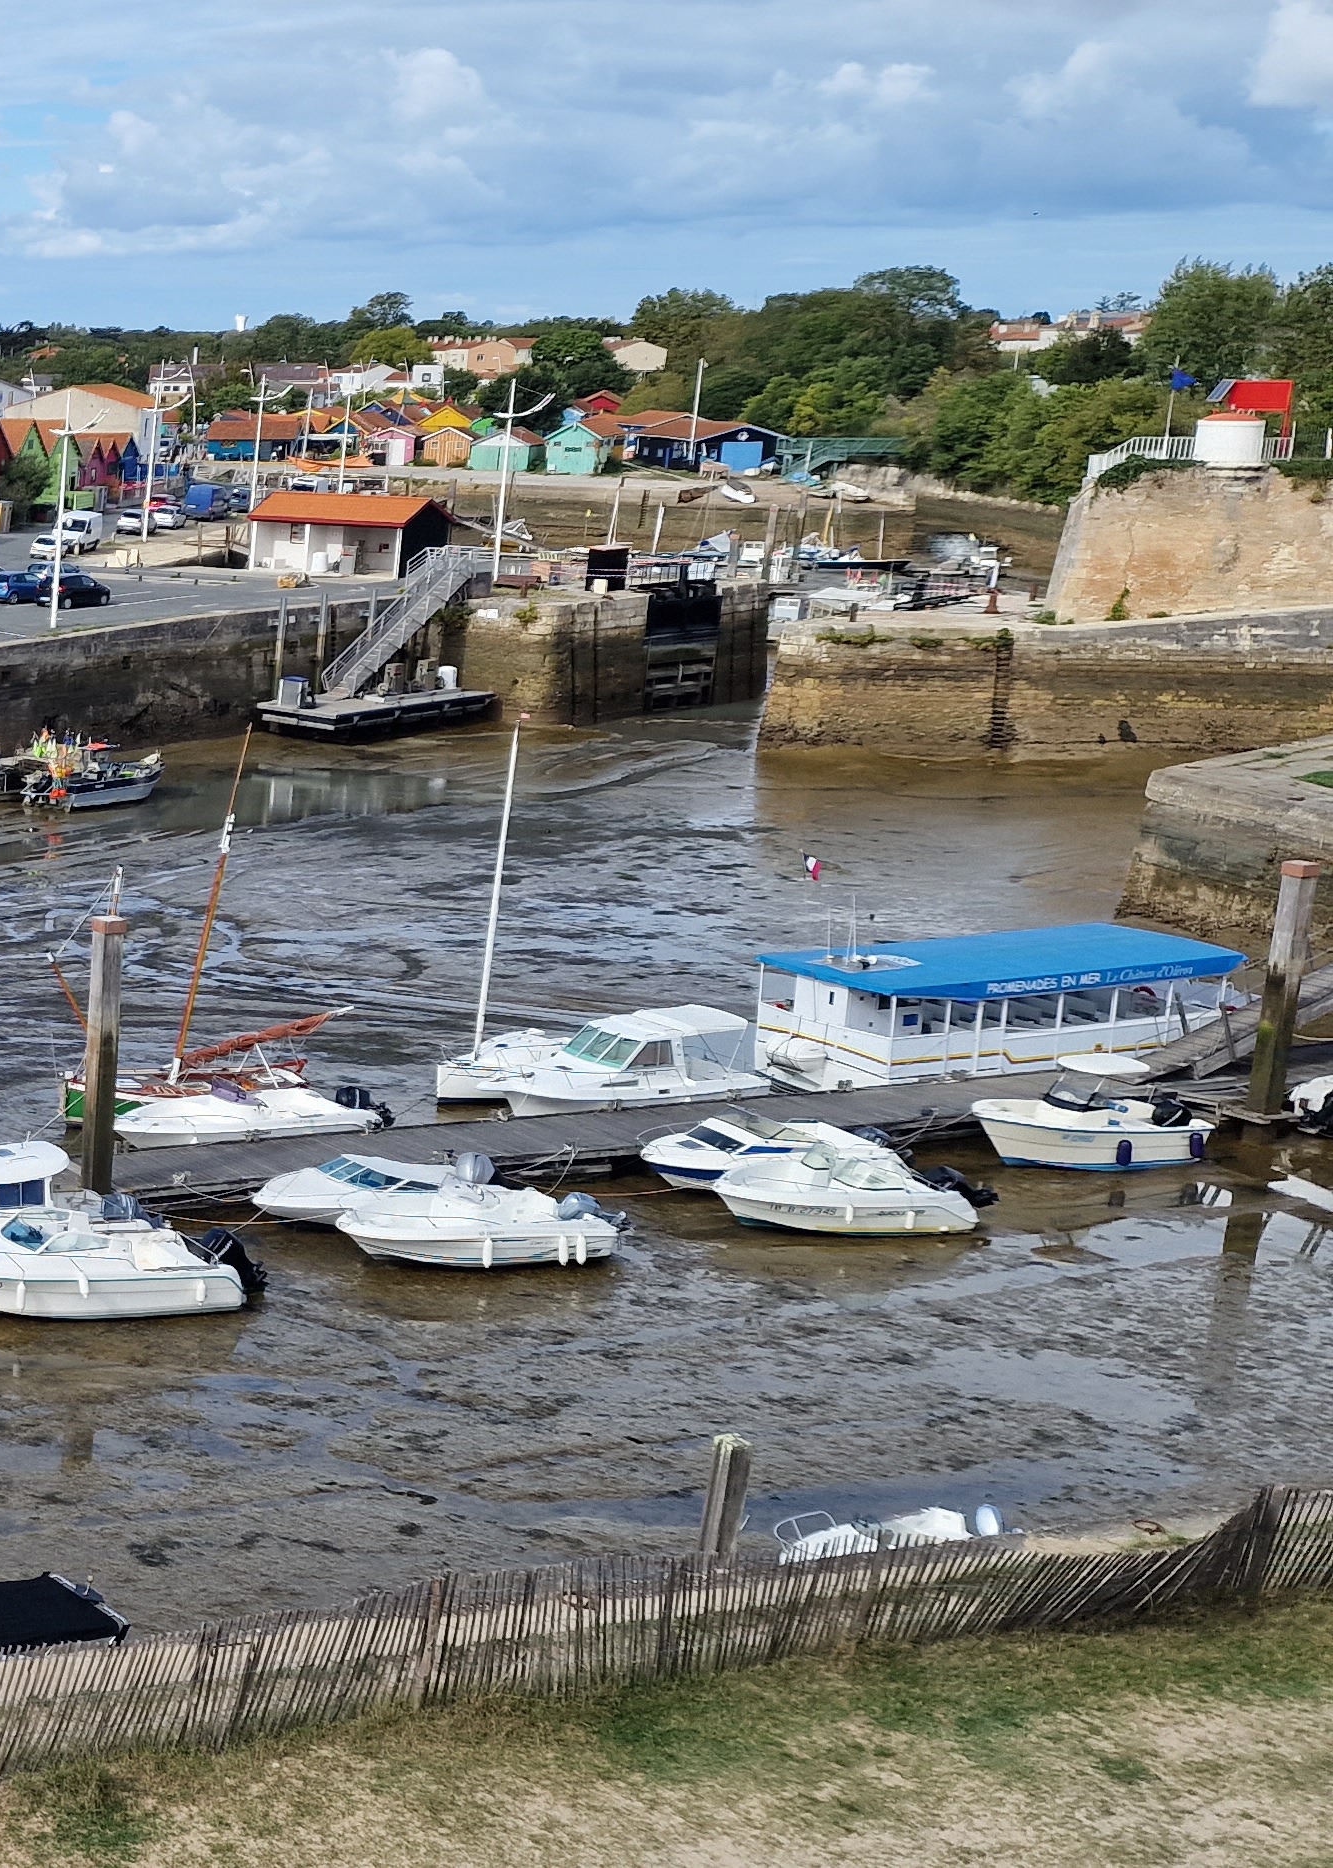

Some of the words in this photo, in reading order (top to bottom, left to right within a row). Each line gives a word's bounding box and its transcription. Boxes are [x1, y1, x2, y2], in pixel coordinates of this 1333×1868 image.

[986, 978, 1058, 994] PROMENADES
[1061, 975, 1077, 987] EN
[1079, 973, 1101, 985] MER
